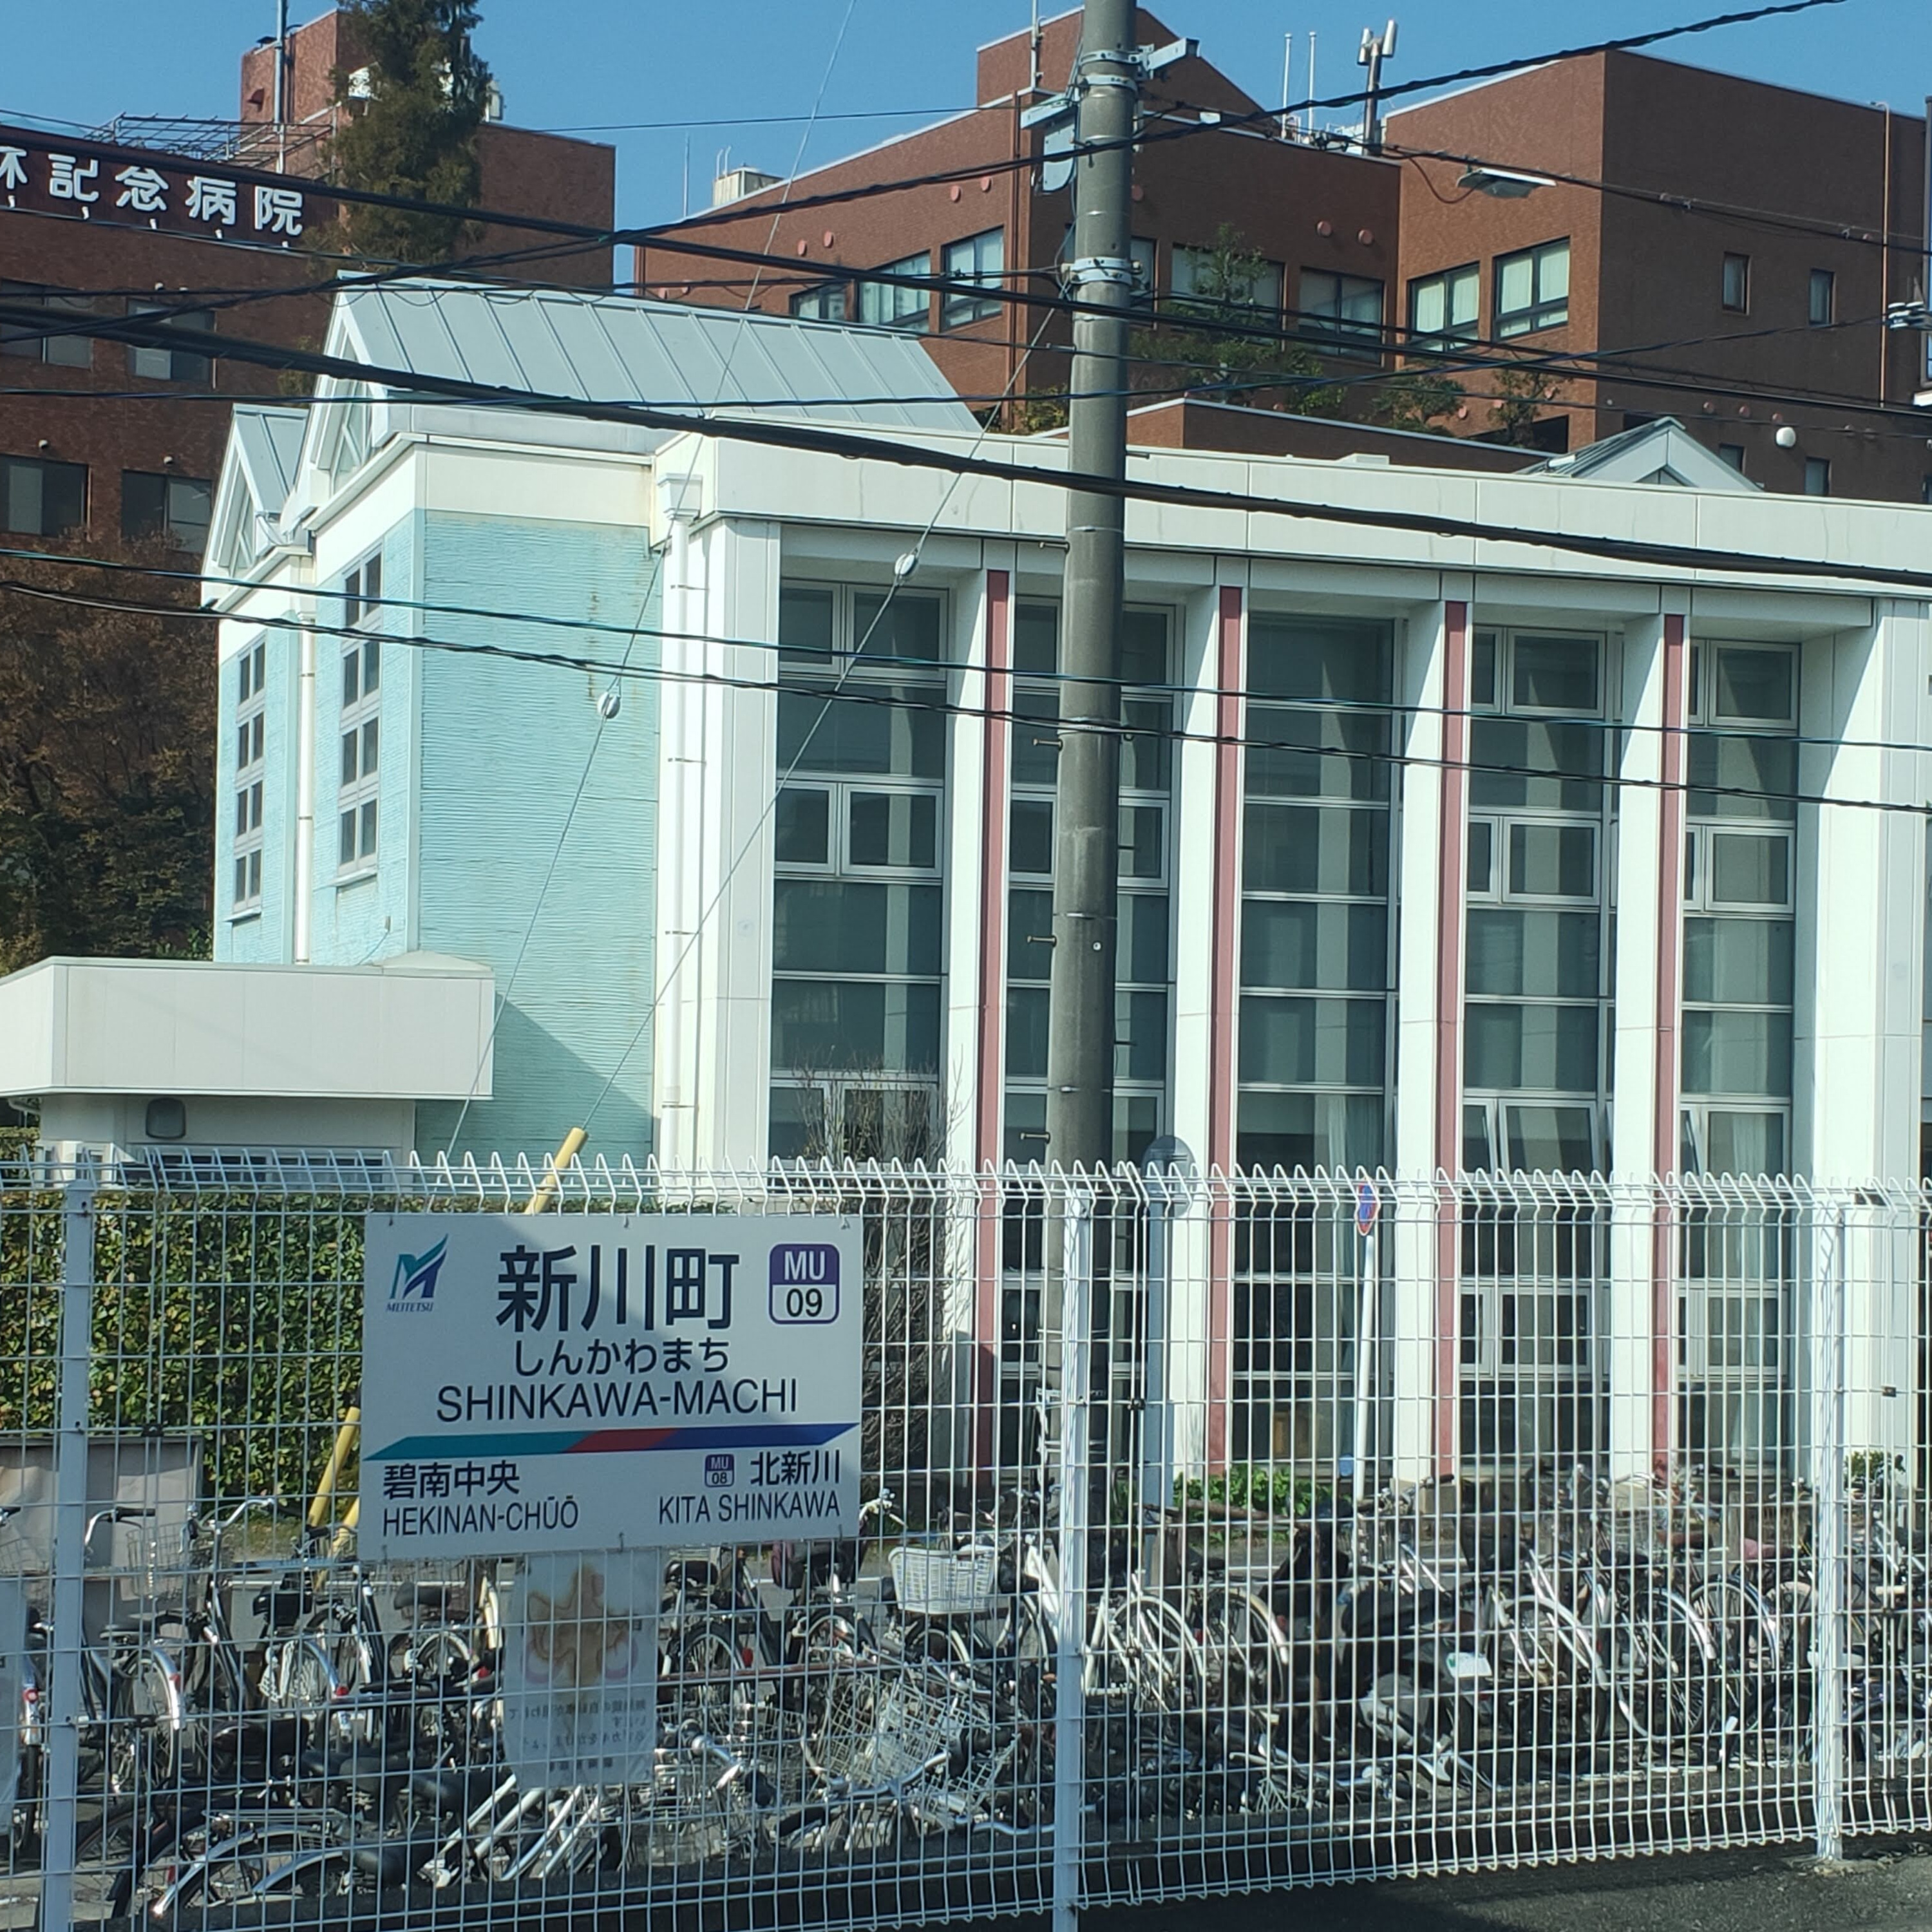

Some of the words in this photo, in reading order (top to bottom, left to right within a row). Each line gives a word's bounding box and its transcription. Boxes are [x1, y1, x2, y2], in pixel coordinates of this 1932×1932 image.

[784, 1250, 826, 1280] MU
[496, 1244, 739, 1332] 新川町
[786, 1287, 823, 1318] 09
[386, 1302, 435, 1312] MEITETSU
[515, 1336, 729, 1376] しんかわまち
[436, 1378, 797, 1423] SHINKAWA-MACHI
[383, 1460, 520, 1500] 碧南中央
[710, 1456, 728, 1470] MU
[712, 1472, 727, 1484] 08
[750, 1449, 840, 1486] 北新川
[383, 1495, 579, 1537] HEKINAN-CHŪŌ
[659, 1495, 711, 1524] KITA
[718, 1490, 840, 1522] SHINKAWA
